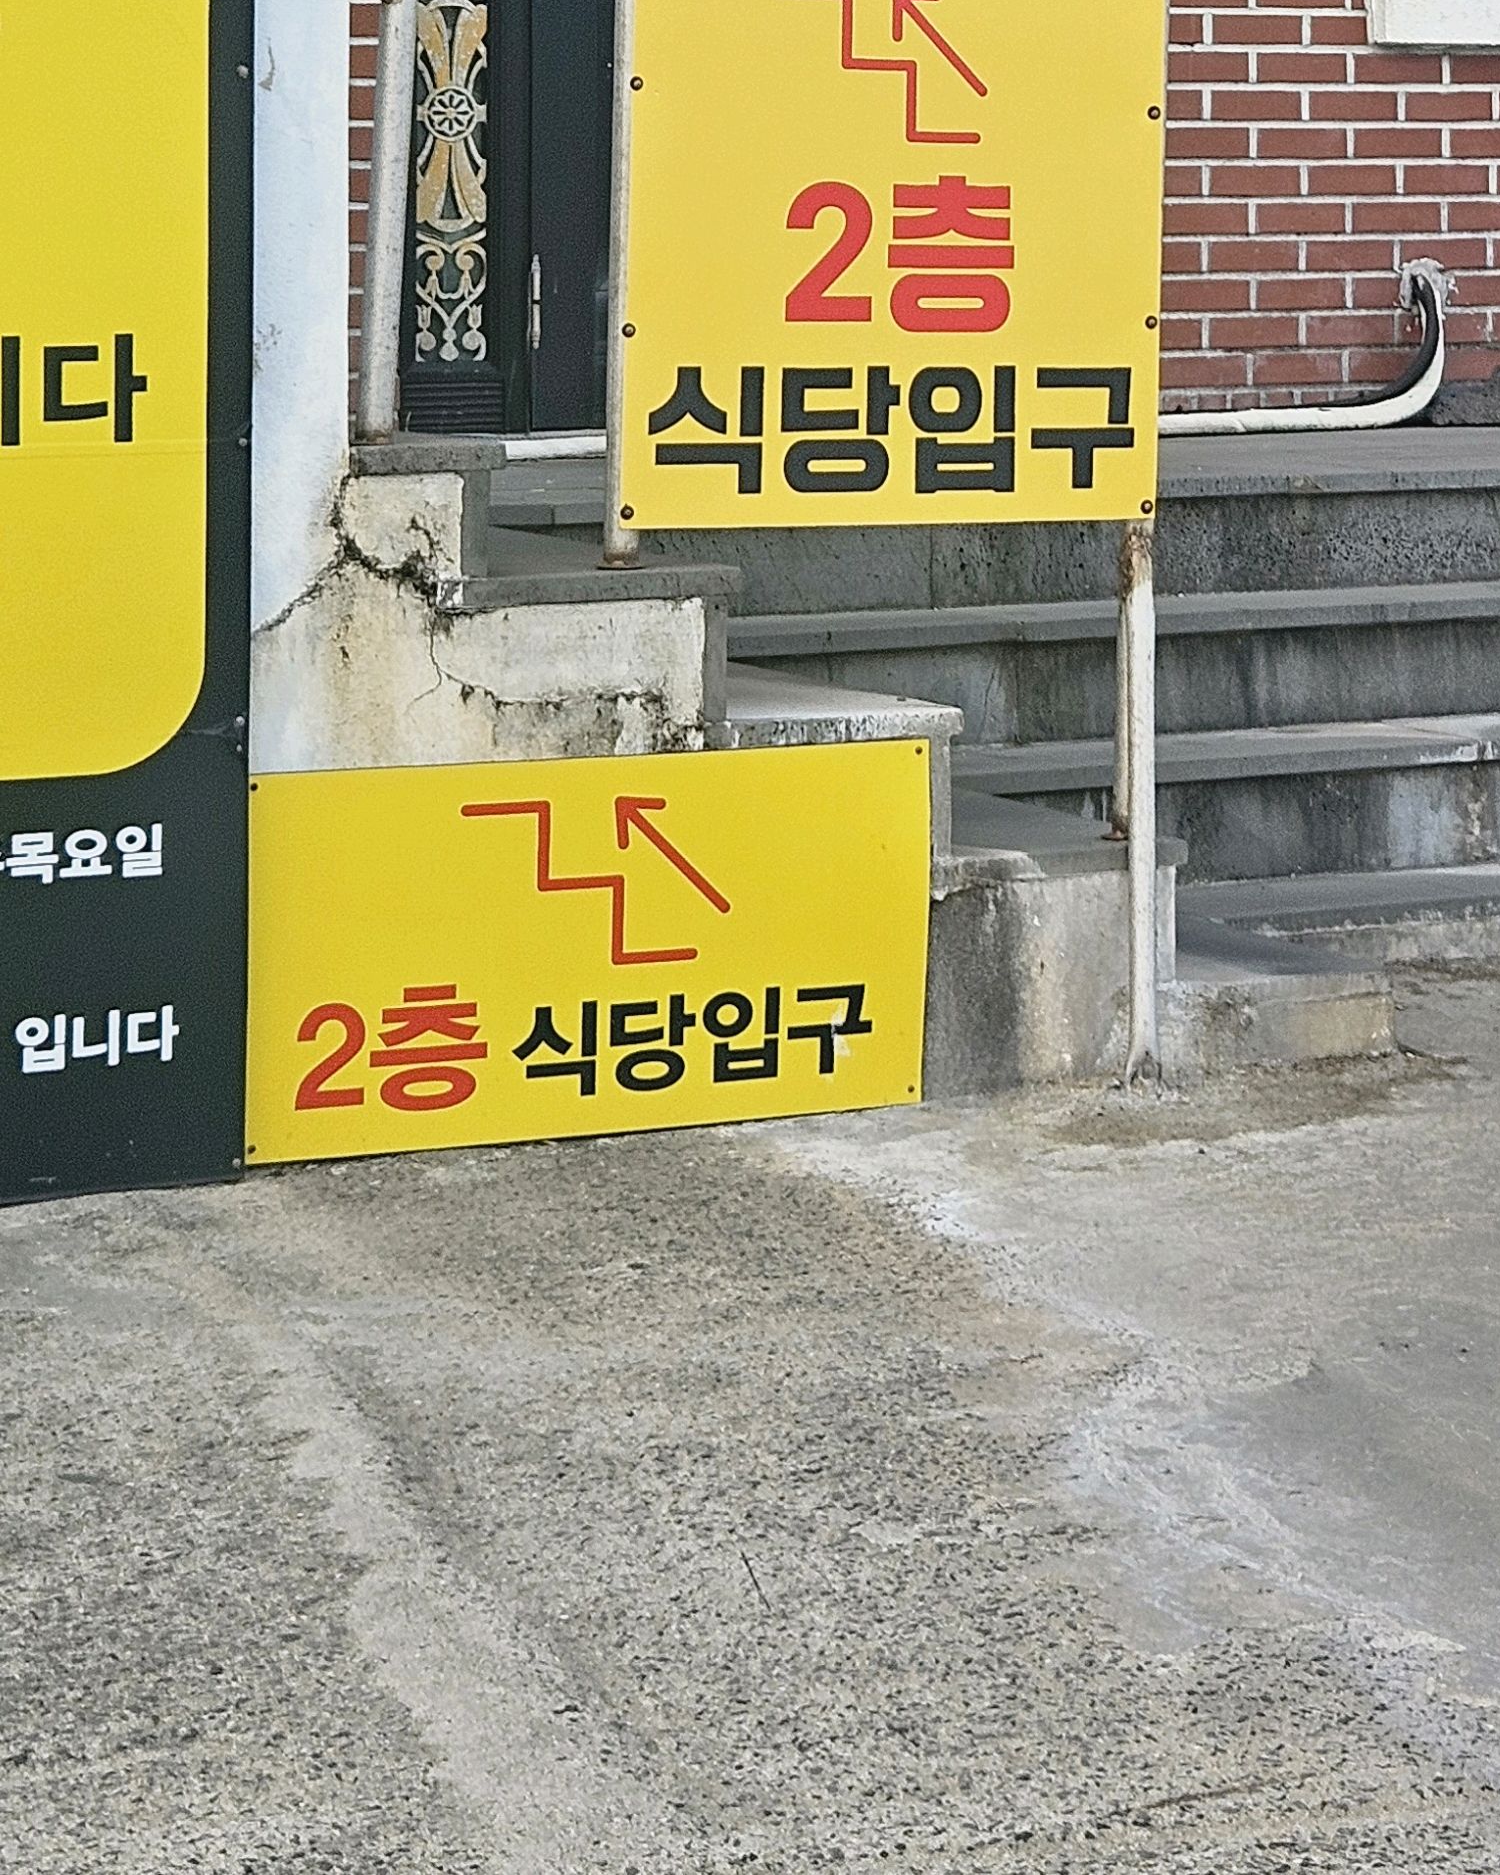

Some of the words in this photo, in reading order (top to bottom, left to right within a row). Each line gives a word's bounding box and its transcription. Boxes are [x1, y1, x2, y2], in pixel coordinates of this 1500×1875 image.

[784, 174, 1016, 334] 2층
[0, 333, 149, 447] 다
[647, 364, 1136, 495] 식당입구
[0, 822, 164, 885] 목요일
[14, 1003, 181, 1075] 입니다
[294, 983, 489, 1113] 2층
[512, 983, 873, 1097] 식당입구
